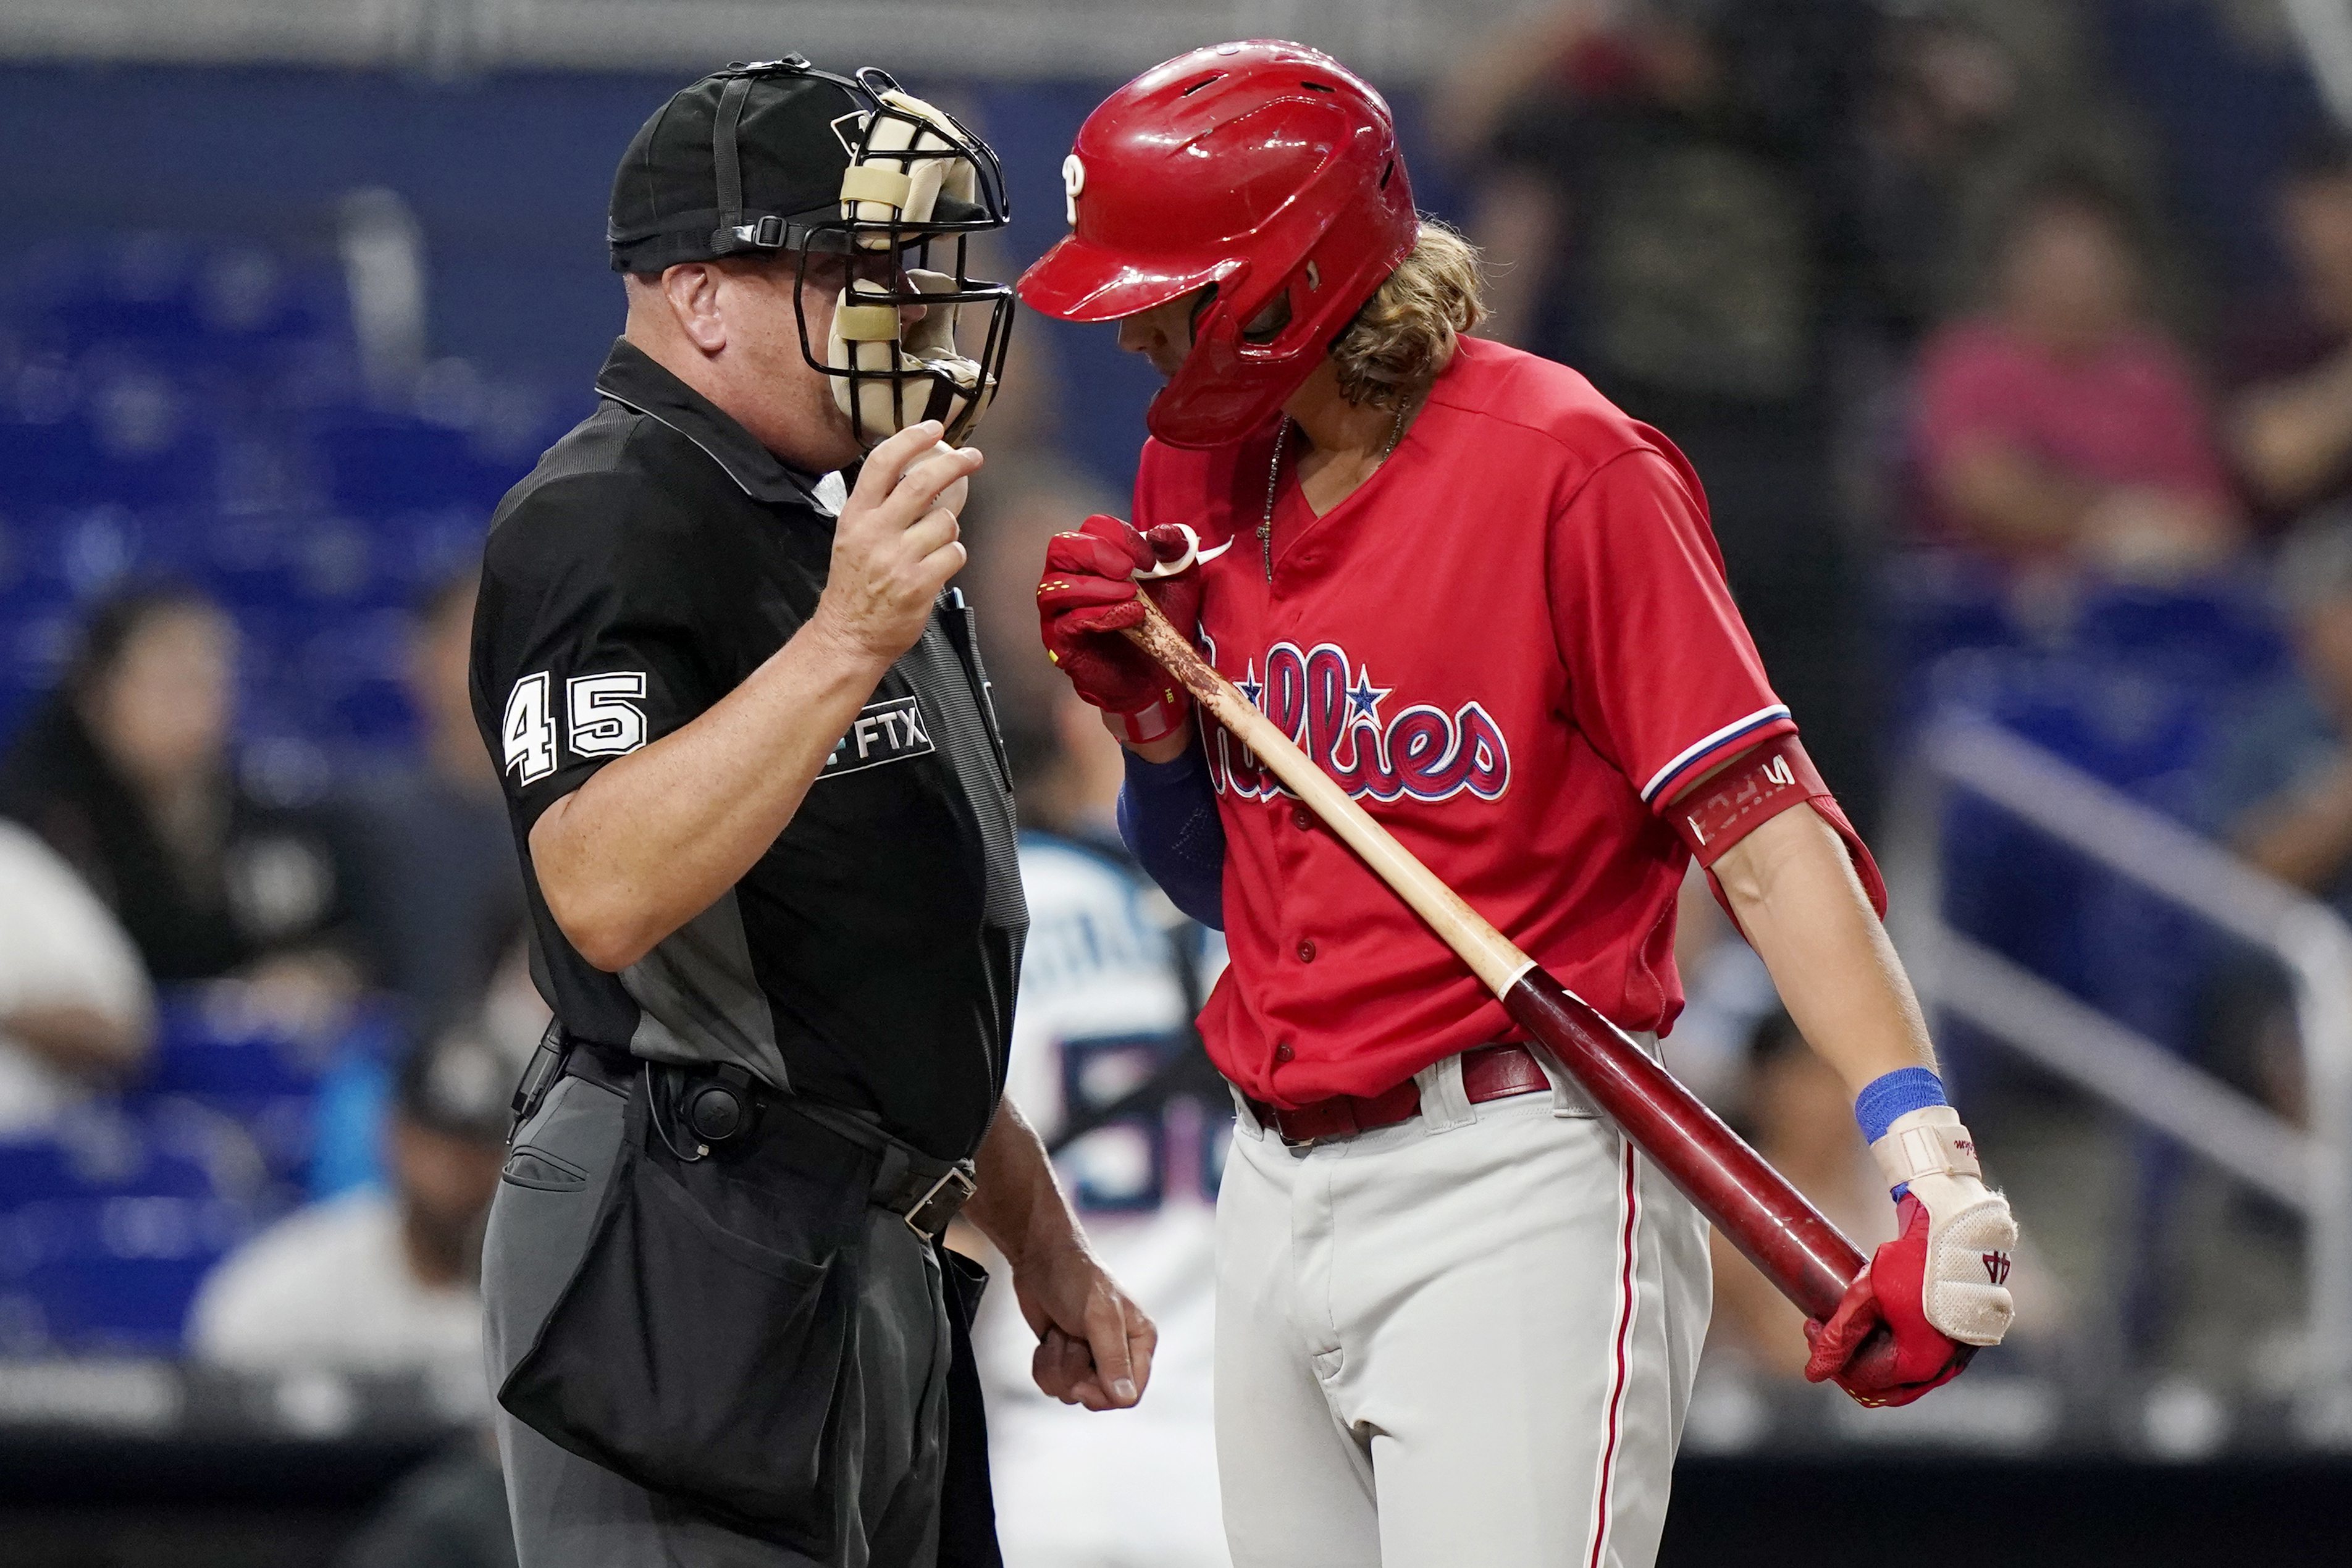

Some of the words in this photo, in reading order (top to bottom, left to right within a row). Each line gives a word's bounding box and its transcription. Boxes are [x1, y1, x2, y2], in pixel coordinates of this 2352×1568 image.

[1061, 154, 1086, 227] P
[502, 670, 648, 787] 45
[854, 707, 928, 759] FTX
